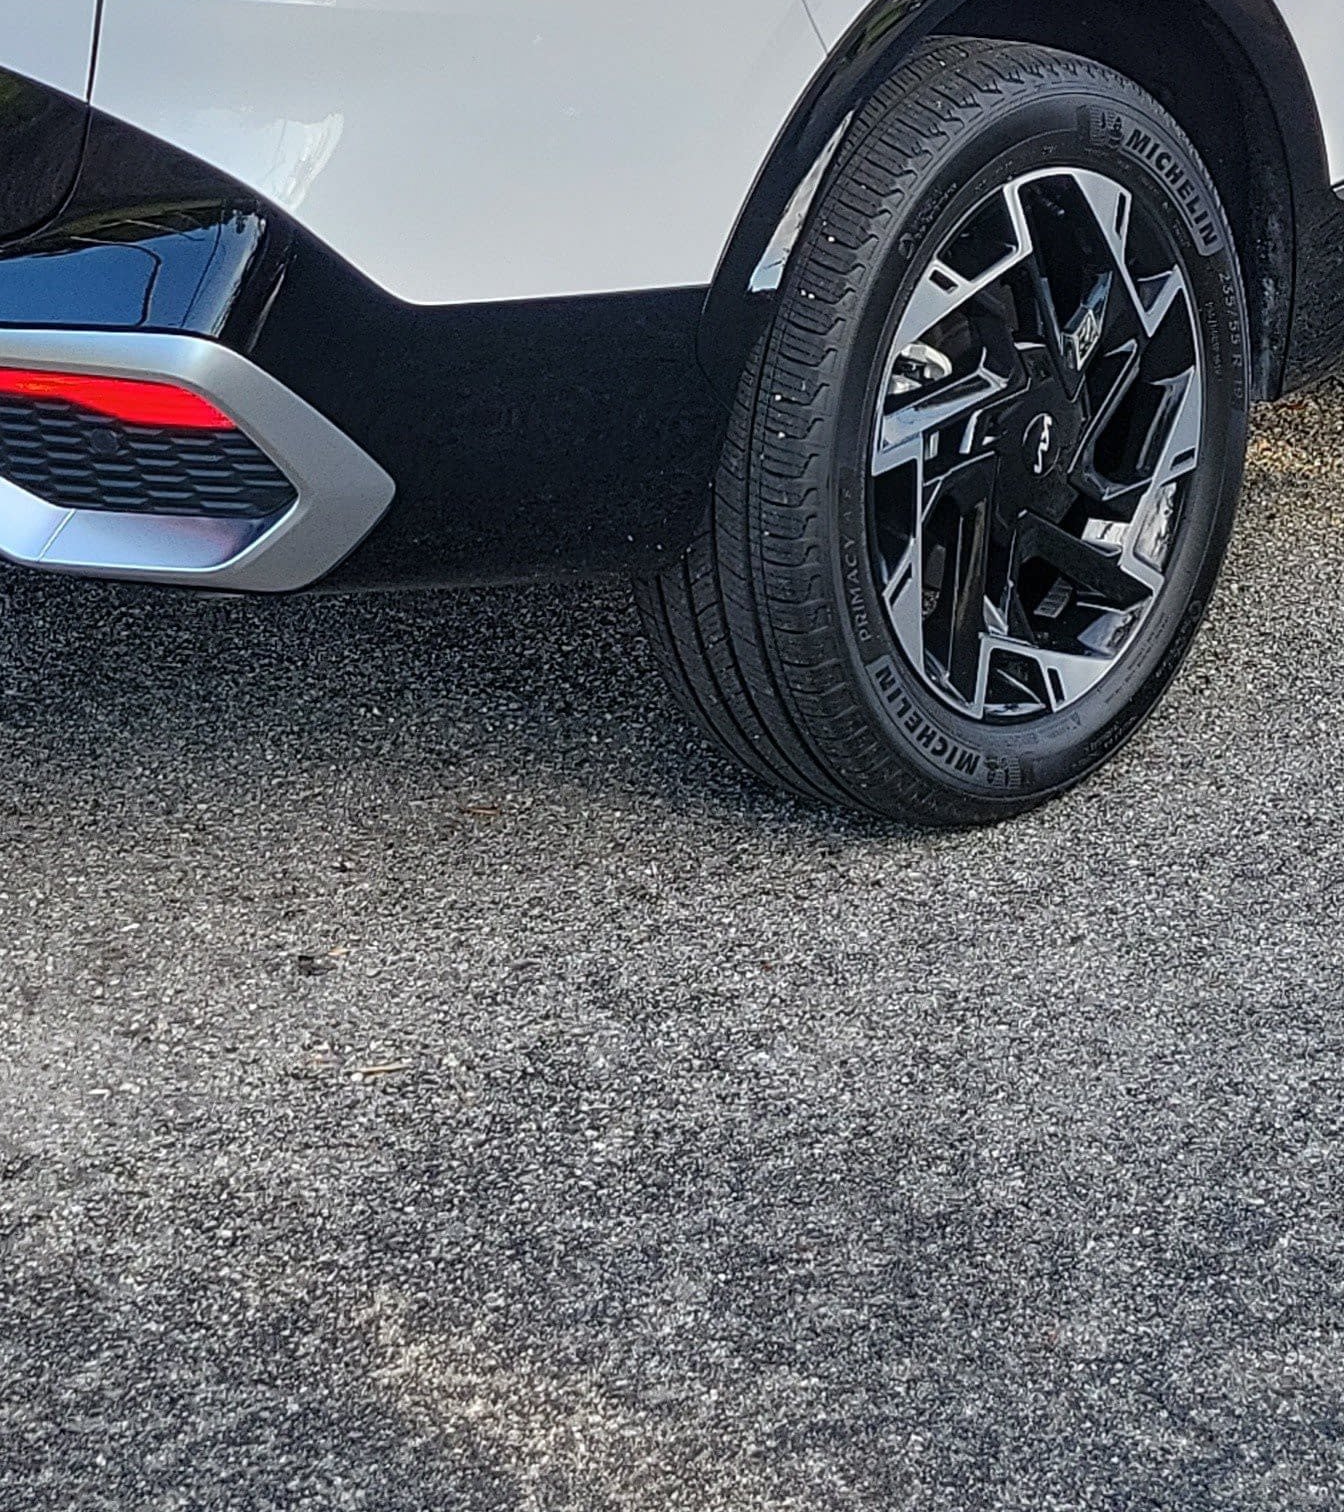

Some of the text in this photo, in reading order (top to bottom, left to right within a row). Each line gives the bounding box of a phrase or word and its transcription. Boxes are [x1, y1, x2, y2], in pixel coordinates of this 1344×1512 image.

[1125, 126, 1220, 247] MICHELIN
[843, 538, 872, 642] PRIMACY
[873, 663, 982, 778] MICHELIN
